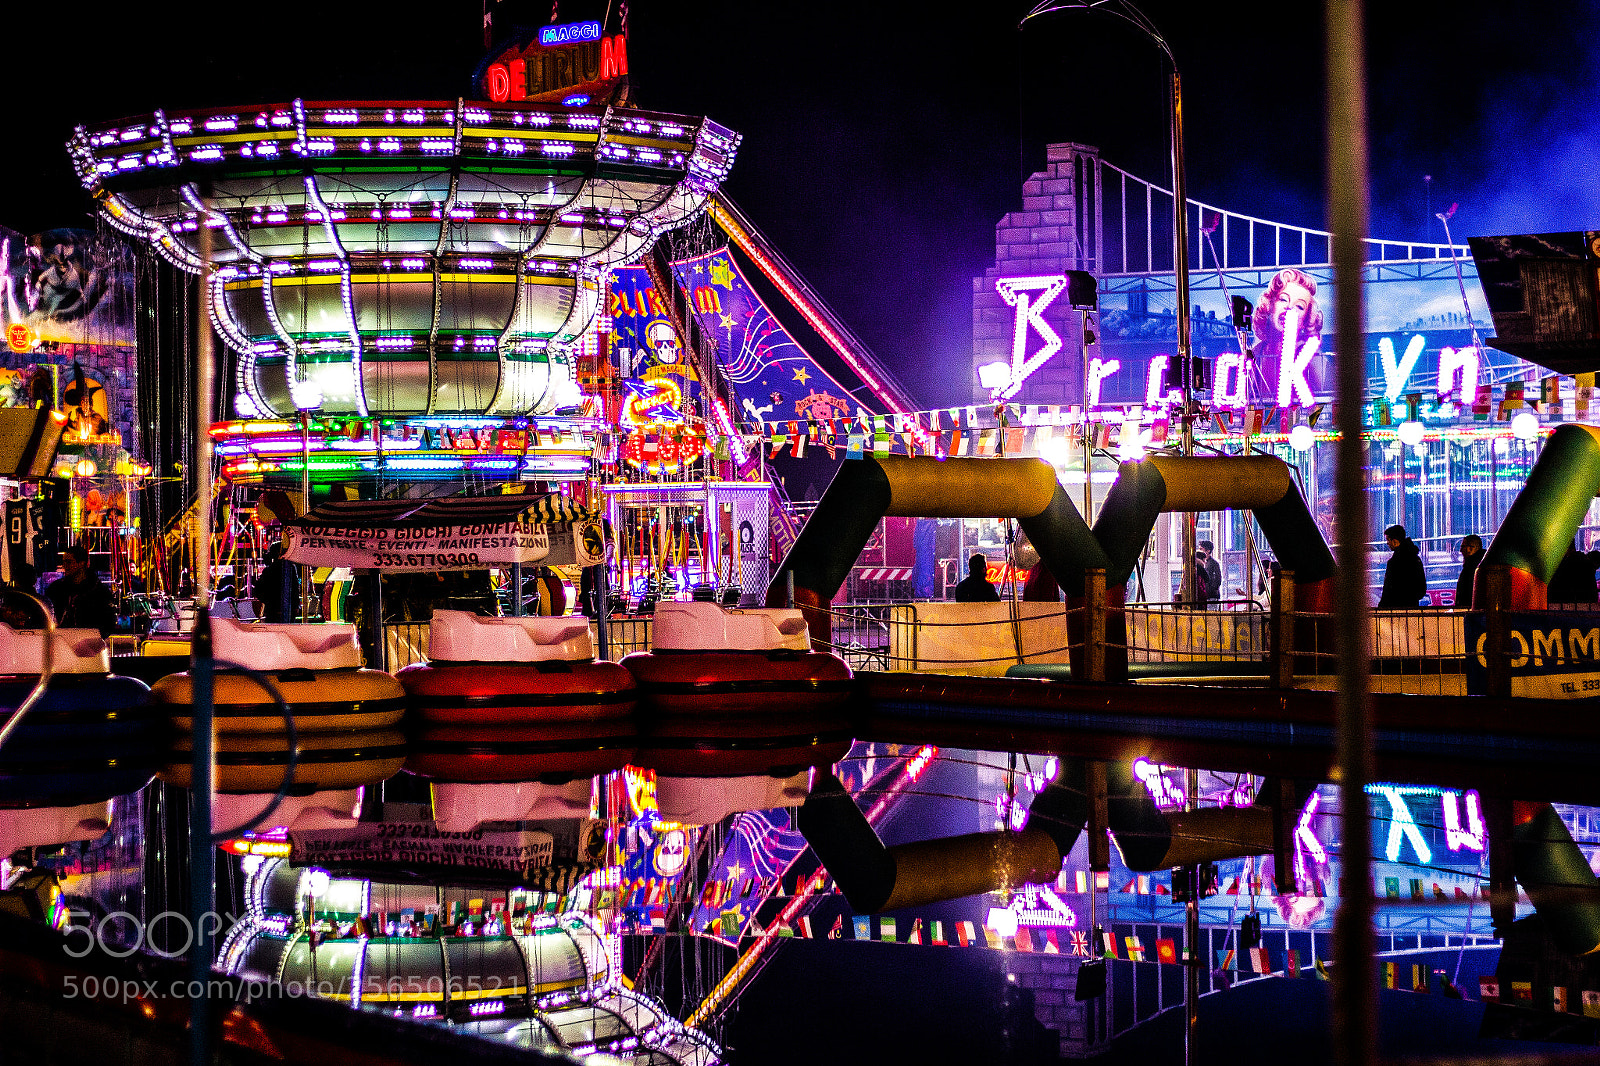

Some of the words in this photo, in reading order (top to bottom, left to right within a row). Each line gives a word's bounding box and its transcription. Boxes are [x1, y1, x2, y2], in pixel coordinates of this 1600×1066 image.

[543, 23, 599, 43] MAGGI
[487, 34, 628, 103] DELIRIUM
[980, 274, 1479, 408] Brookyn
[395, 525, 453, 539] GIOCHI
[459, 521, 548, 537] GONFIABILI
[300, 537, 326, 548] PER
[330, 539, 366, 549] FESTE
[378, 540, 427, 550] EVENTI
[438, 537, 549, 549] MANIFESTAZIONI
[373, 552, 479, 567] 333.6770309
[1561, 682, 1579, 693] TEL.
